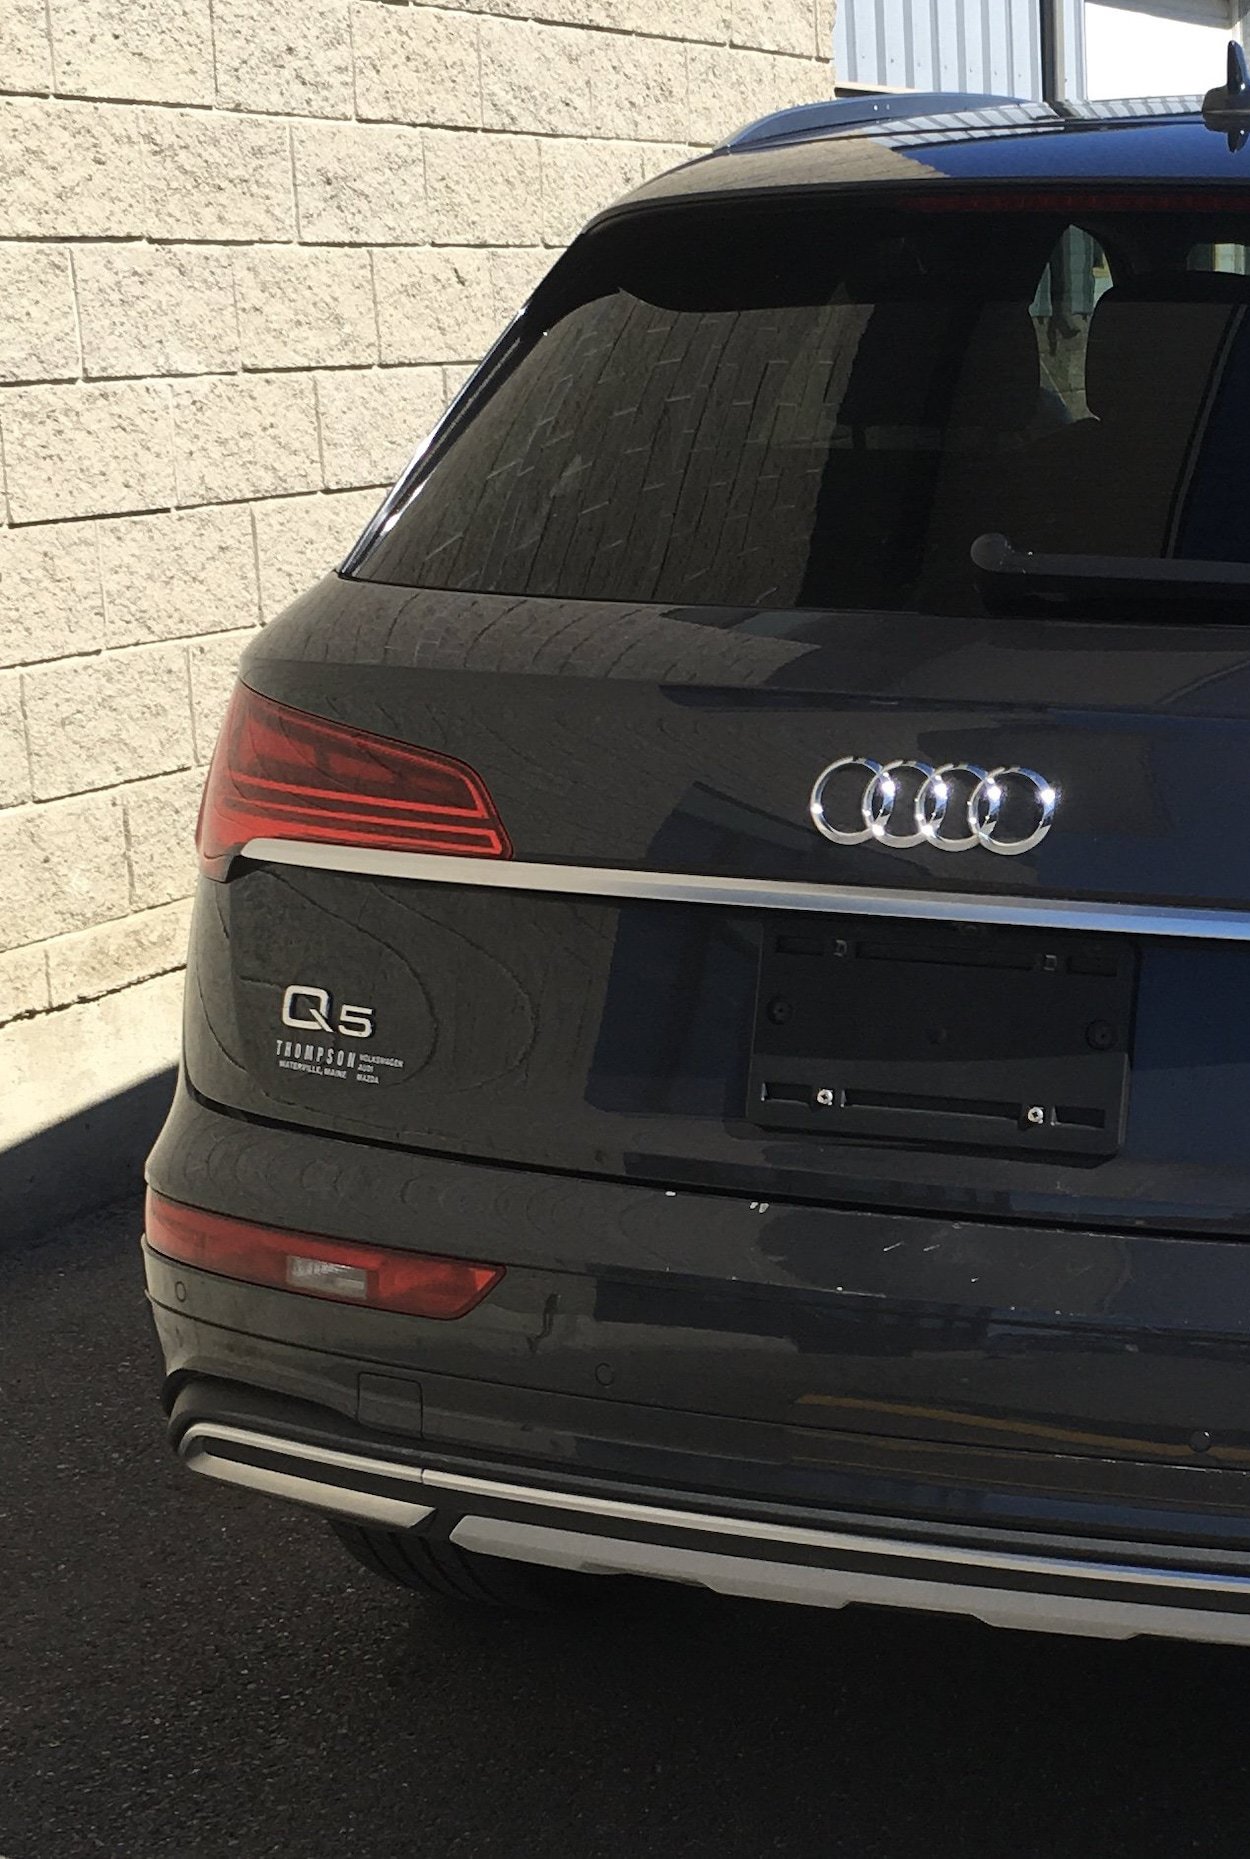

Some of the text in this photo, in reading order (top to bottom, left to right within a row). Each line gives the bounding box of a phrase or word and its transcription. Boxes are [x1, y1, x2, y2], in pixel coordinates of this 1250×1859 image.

[282, 984, 374, 1038] Q5
[276, 1039, 356, 1069] THOMPSON
[356, 1073, 379, 1085] MAZDA
